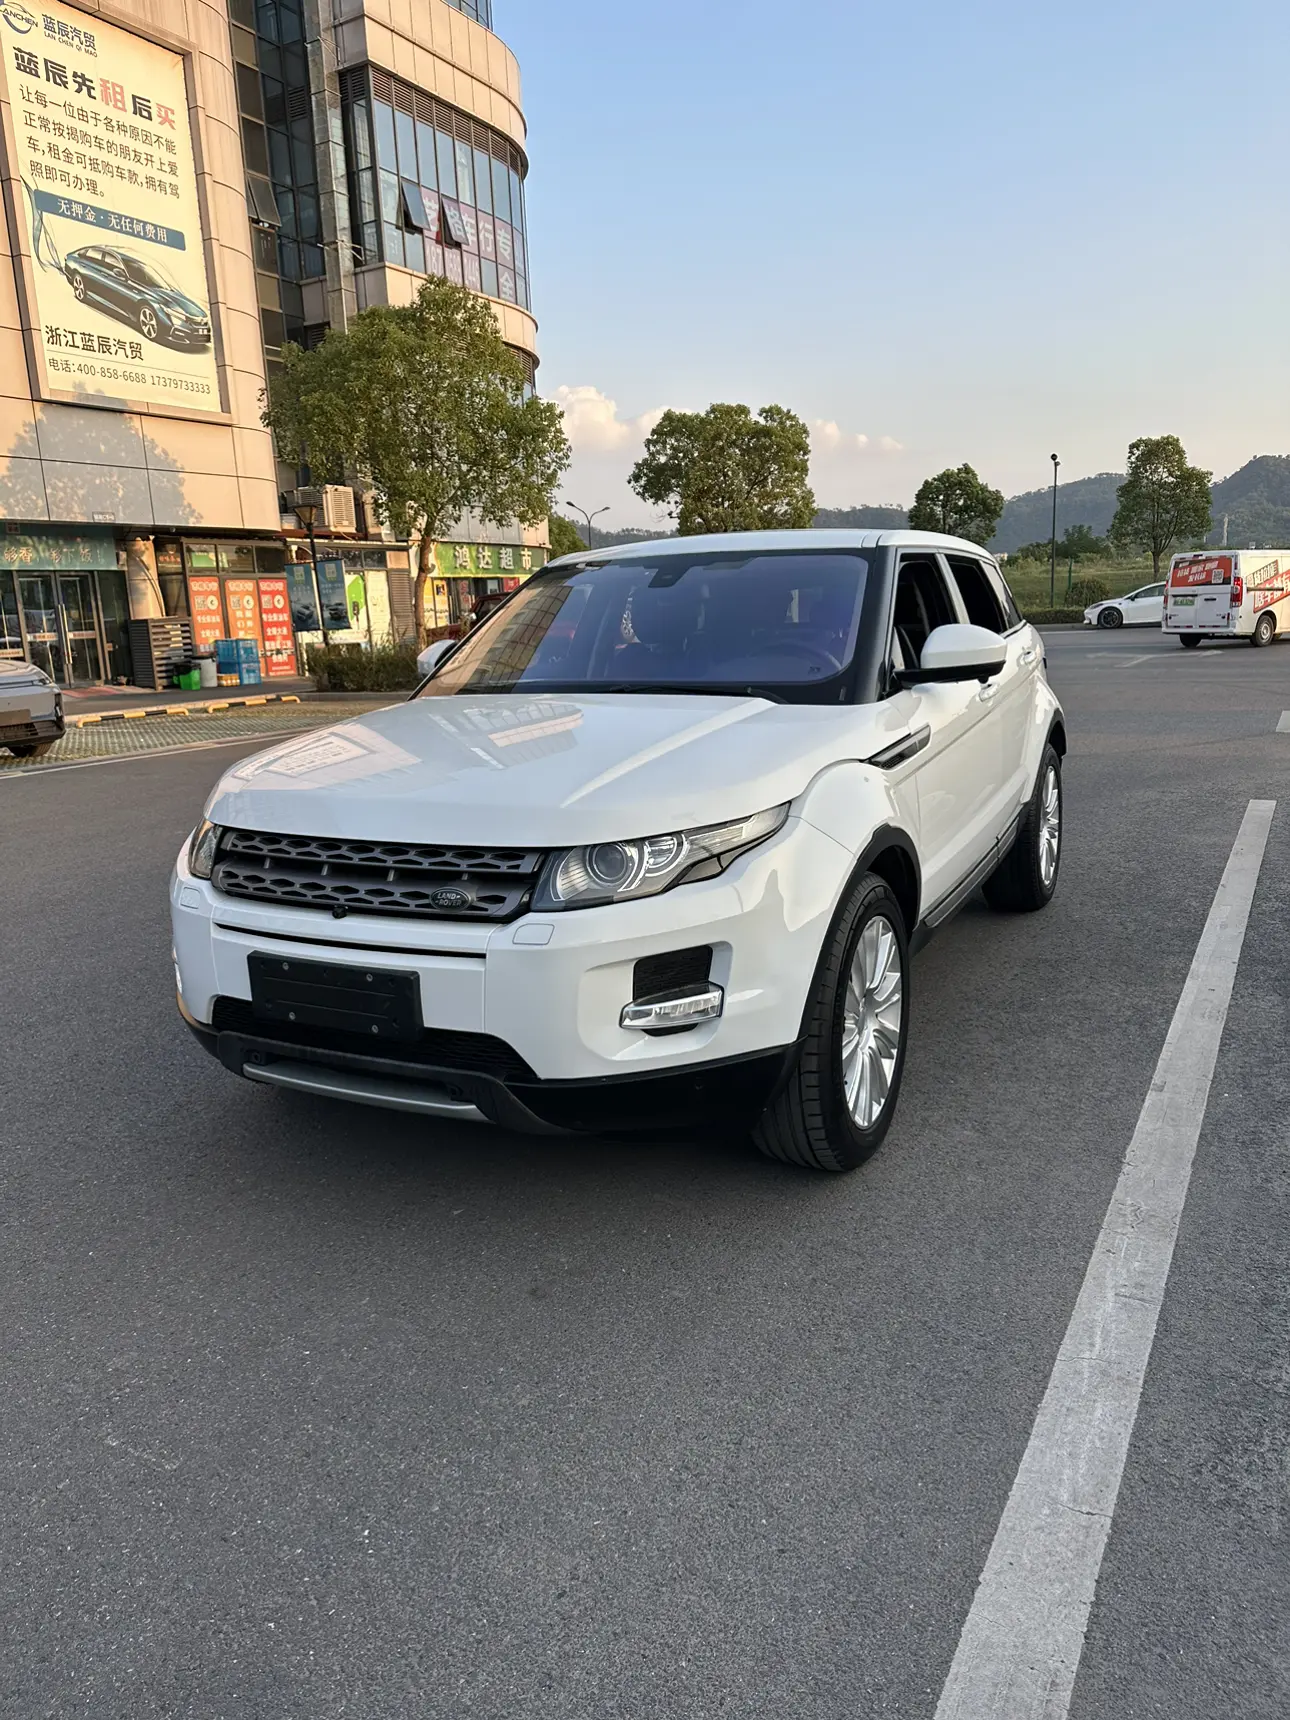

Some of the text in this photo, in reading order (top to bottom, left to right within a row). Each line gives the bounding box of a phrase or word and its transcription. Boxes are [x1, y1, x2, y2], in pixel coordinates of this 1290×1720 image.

[42, 14, 96, 51] 蓝辰汽贸
[13, 46, 176, 130] 蓝辰先租后买
[19, 84, 176, 155] 让每一位由于各种原因不能
[23, 109, 179, 178] 正常按揭购车的朋友开上爱
[30, 159, 105, 198] 照即可办理。
[45, 325, 144, 361] 浙江蓝辰汽贸
[455, 545, 533, 570] 鸿达超市
[437, 892, 457, 900] LAND
